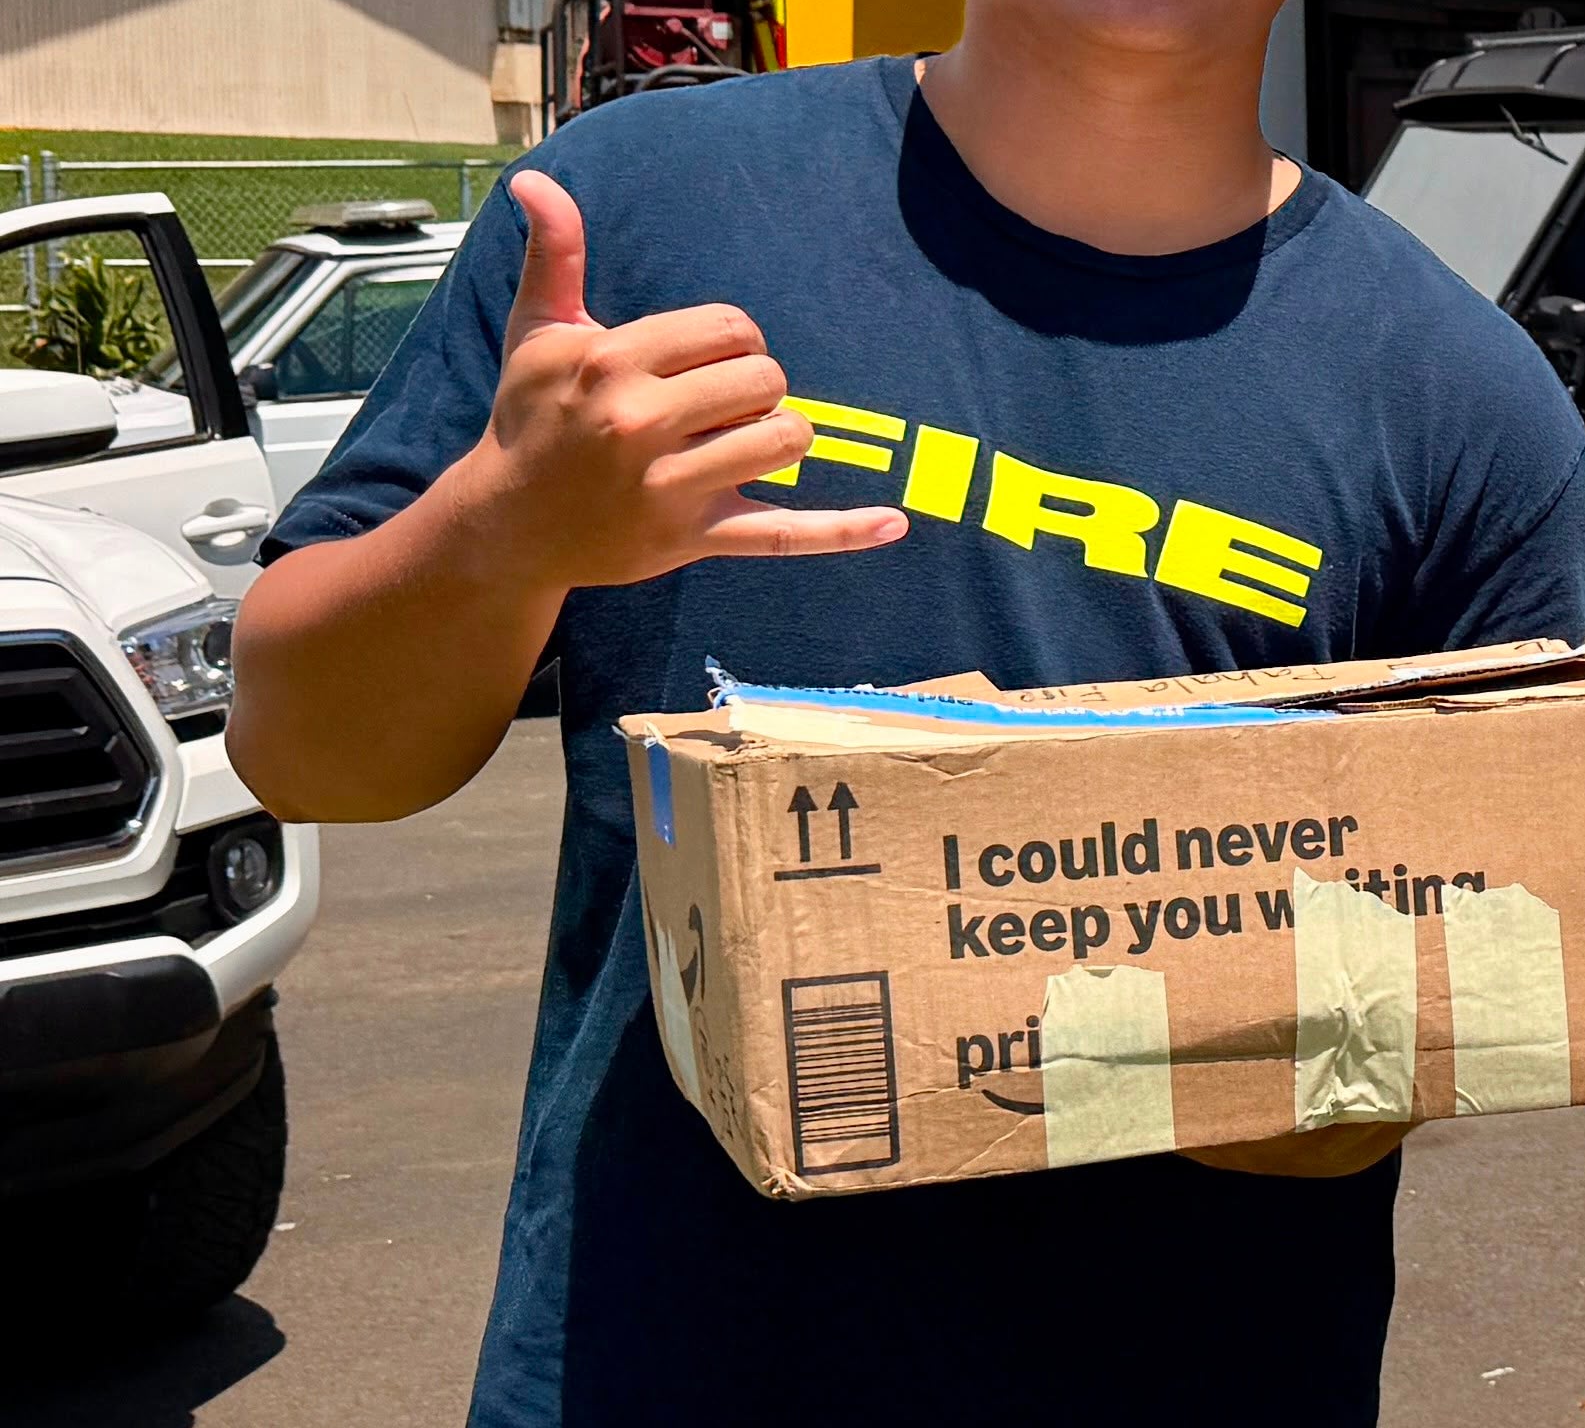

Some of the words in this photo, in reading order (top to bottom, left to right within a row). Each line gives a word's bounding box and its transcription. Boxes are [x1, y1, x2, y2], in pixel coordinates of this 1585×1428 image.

[757, 395, 1323, 628] FIRE
[943, 834, 961, 890] I
[978, 818, 1161, 888] could
[1175, 815, 1358, 870] never
[947, 903, 1111, 960] keep
[1123, 892, 1242, 955] you
[956, 1014, 1043, 1090] pri
